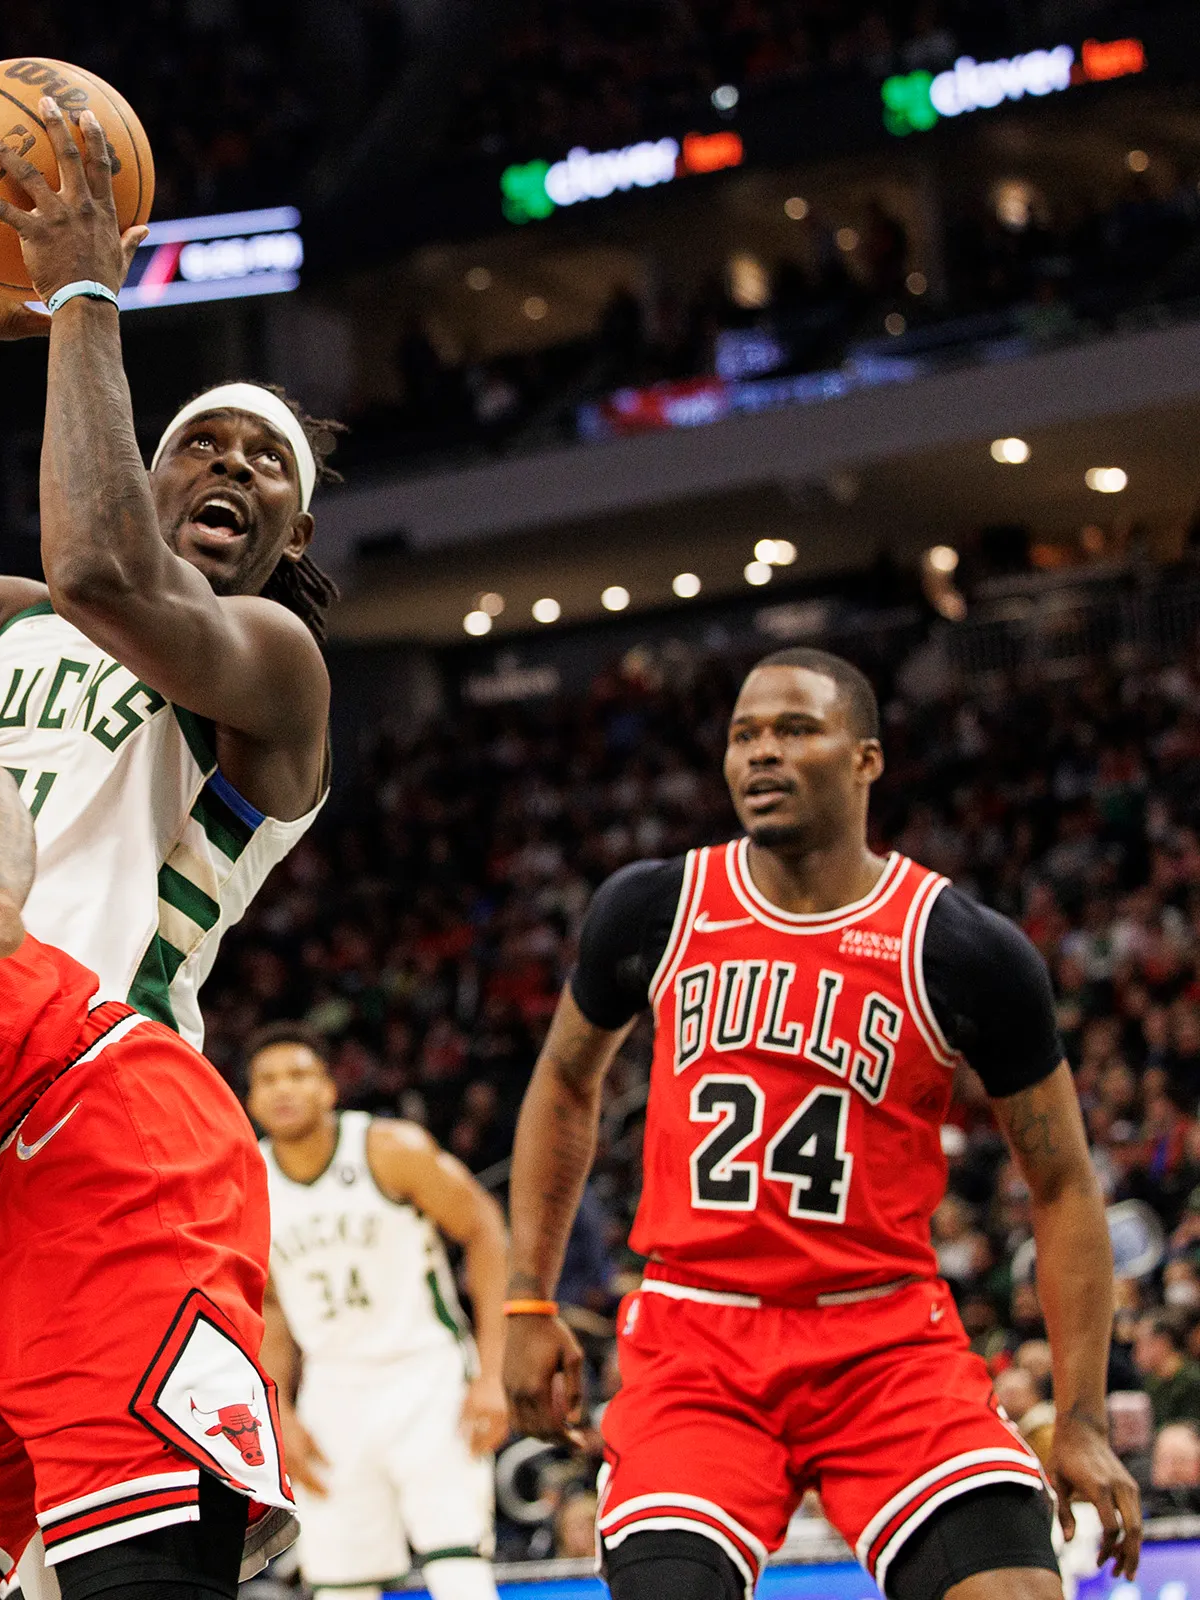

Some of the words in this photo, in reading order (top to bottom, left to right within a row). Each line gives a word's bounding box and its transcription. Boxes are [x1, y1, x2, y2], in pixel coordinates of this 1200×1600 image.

[2, 766, 60, 824] 1
[674, 959, 904, 1106] BULLS
[689, 1073, 853, 1224] 24
